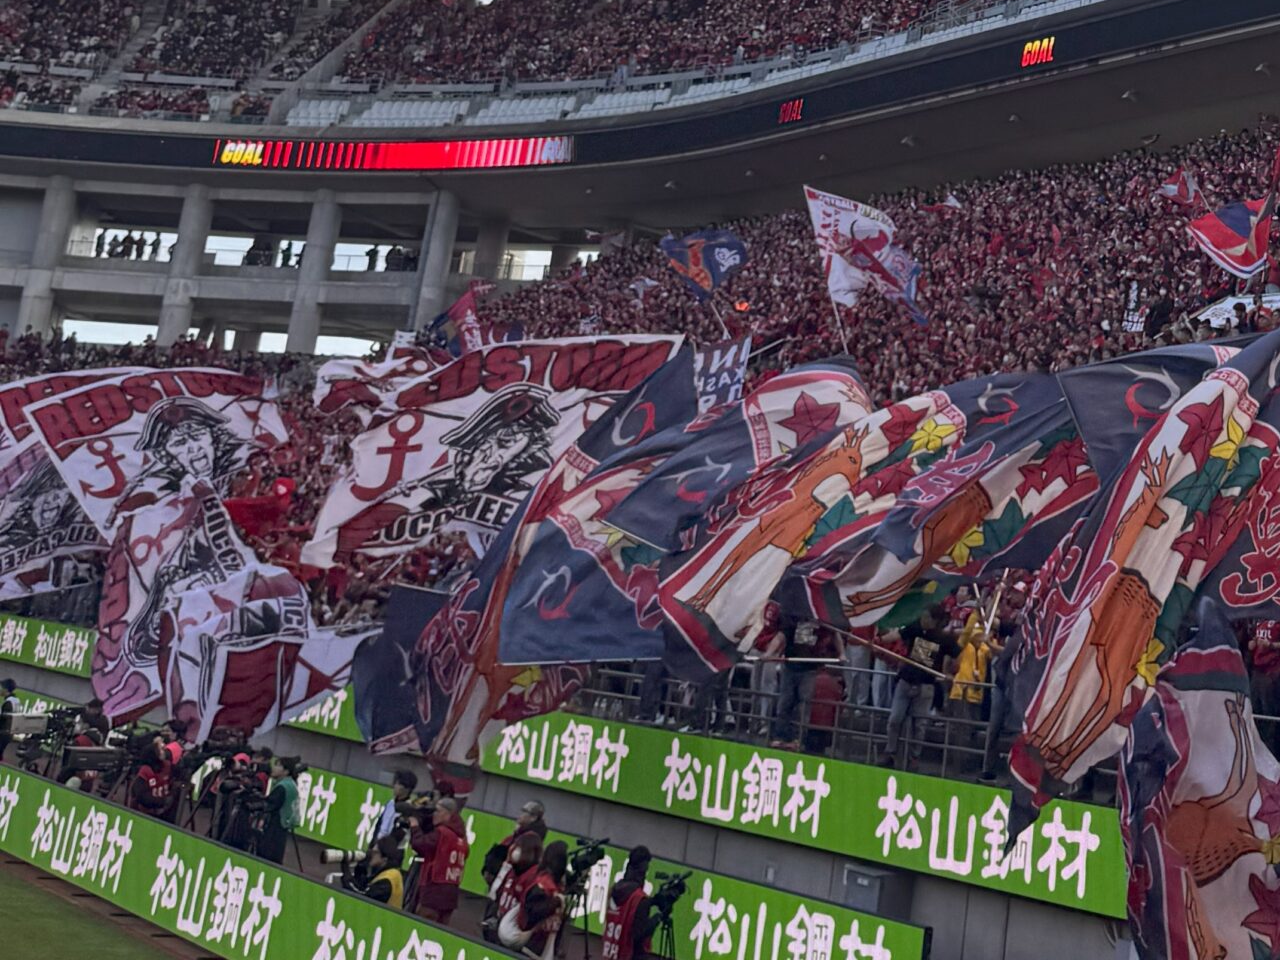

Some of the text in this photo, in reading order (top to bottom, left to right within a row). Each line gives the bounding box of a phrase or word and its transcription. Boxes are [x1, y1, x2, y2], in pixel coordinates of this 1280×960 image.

[1021, 36, 1054, 68] GOAL
[779, 98, 803, 124] GOAL
[221, 141, 263, 164] GOAL
[497, 721, 628, 791] 松山鋼材
[662, 739, 830, 837] 松山鋼材
[32, 791, 132, 891] 松山鋼材
[151, 836, 281, 960] 松山鋼材
